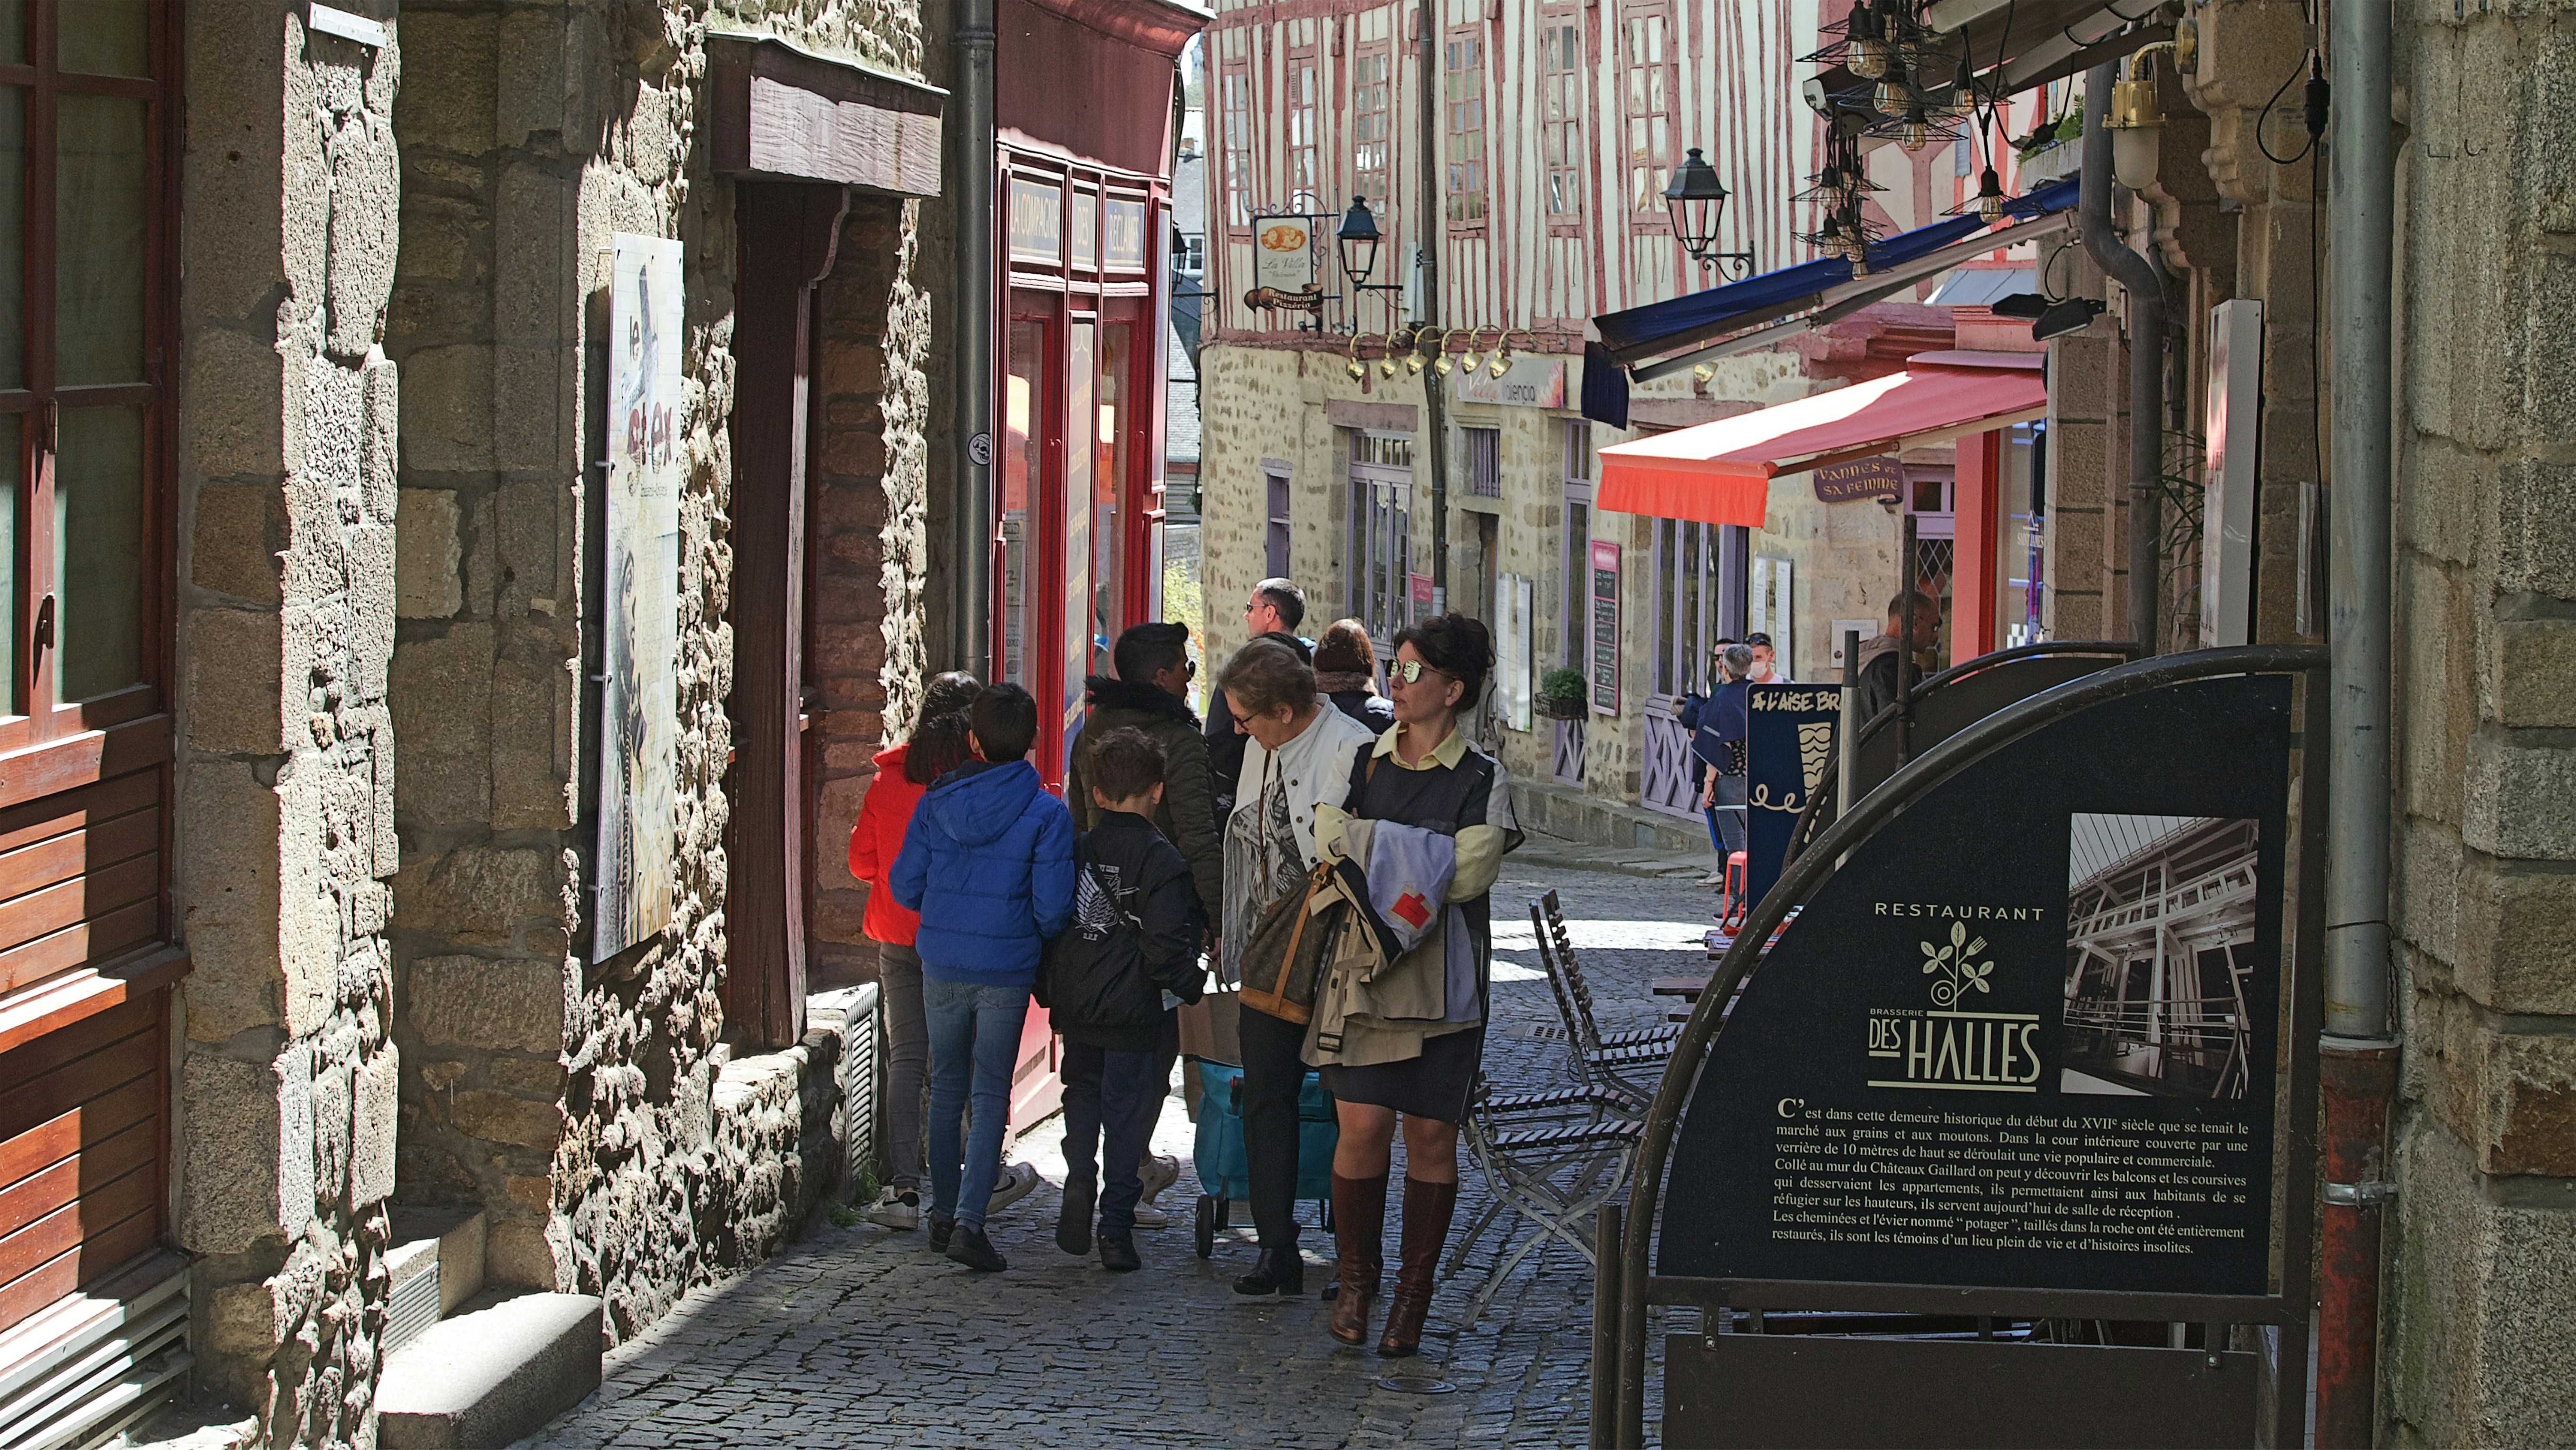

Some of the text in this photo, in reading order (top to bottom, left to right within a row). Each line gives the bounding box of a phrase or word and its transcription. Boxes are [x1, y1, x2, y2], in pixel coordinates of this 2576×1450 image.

[1021, 193, 1058, 241] COMPAGNIE
[1077, 206, 1089, 247] DES
[1108, 208, 1140, 253] RÉCLAMES
[1262, 257, 1305, 269] La Villa
[1268, 289, 1317, 301] Restaurant
[1272, 298, 1311, 309] Pizzéria
[1819, 462, 1880, 481] VANNES
[1823, 477, 1899, 496] SA FEMME
[1875, 902, 2045, 921] RESTAURANT
[1869, 1007, 1924, 1017] BRASSERIE
[1868, 1017, 2041, 1084] DES HALLES
[1826, 1108, 1853, 1120] dans
[1857, 1112, 1885, 1121] cette
[1889, 1112, 1940, 1123] demeure
[1944, 1112, 2002, 1128] historique
[2006, 1114, 2021, 1126] du
[2025, 1115, 2058, 1128] début
[2062, 1117, 2077, 1128] du
[2121, 1119, 2155, 1131] siècle
[2158, 1123, 2180, 1134] que
[2184, 1123, 2197, 1132] se
[2201, 1122, 2234, 1134] tenait
[2238, 1123, 2249, 1134] le
[1776, 1125, 2248, 1153] marché aux grains et aux moutons. Dans la cour intérieure couverte par une
[1776, 1141, 2215, 1168] verrière de 10 mètres de haut se déroulait une vie populaire et commerciale.
[1775, 1159, 2246, 1186] Collé au mur du Châteaux Gaillard on peut y découvrir les balcons et les coursives
[1774, 1176, 2246, 1203] qui desservaient les appartements, ils permettaient ainsi aux habitants de se
[1773, 1193, 1820, 1208] réfugier
[1823, 1198, 1842, 1206] sur
[1845, 1195, 1861, 1207] les
[1864, 1196, 1917, 1210] hauteurs,
[1921, 1198, 1934, 1209] ils
[1938, 1202, 1980, 1211] servent
[2054, 1203, 2069, 1215] de
[2072, 1204, 2099, 1216] salle
[2102, 1205, 2116, 1216] de
[2119, 1205, 2173, 1220] réception
[1773, 1210, 1794, 1222] Les
[1796, 1211, 1857, 1224] cheminées
[1859, 1215, 1870, 1224] et
[1910, 1216, 1954, 1228] nommé
[2024, 1219, 2058, 1232] taillés
[2060, 1220, 2087, 1232] dans
[2090, 1221, 2100, 1233] la
[2102, 1223, 2134, 1234] roche
[2136, 1225, 2155, 1234] ont
[2157, 1224, 2175, 1236] été
[2177, 1224, 2245, 1238] entièrement
[1772, 1229, 1826, 1241] restaurés,
[1830, 1229, 1843, 1241] ils
[1846, 1232, 1870, 1241] sont
[1874, 1231, 1890, 1243] les
[1893, 1232, 1939, 1244] témoins
[1972, 1234, 1993, 1247] lieu
[1996, 1236, 2025, 1249] plein
[2028, 1237, 2042, 1248] de
[2045, 1237, 2063, 1249] vie
[2066, 1240, 2077, 1249] et
[2143, 1240, 2193, 1253] insolites.
